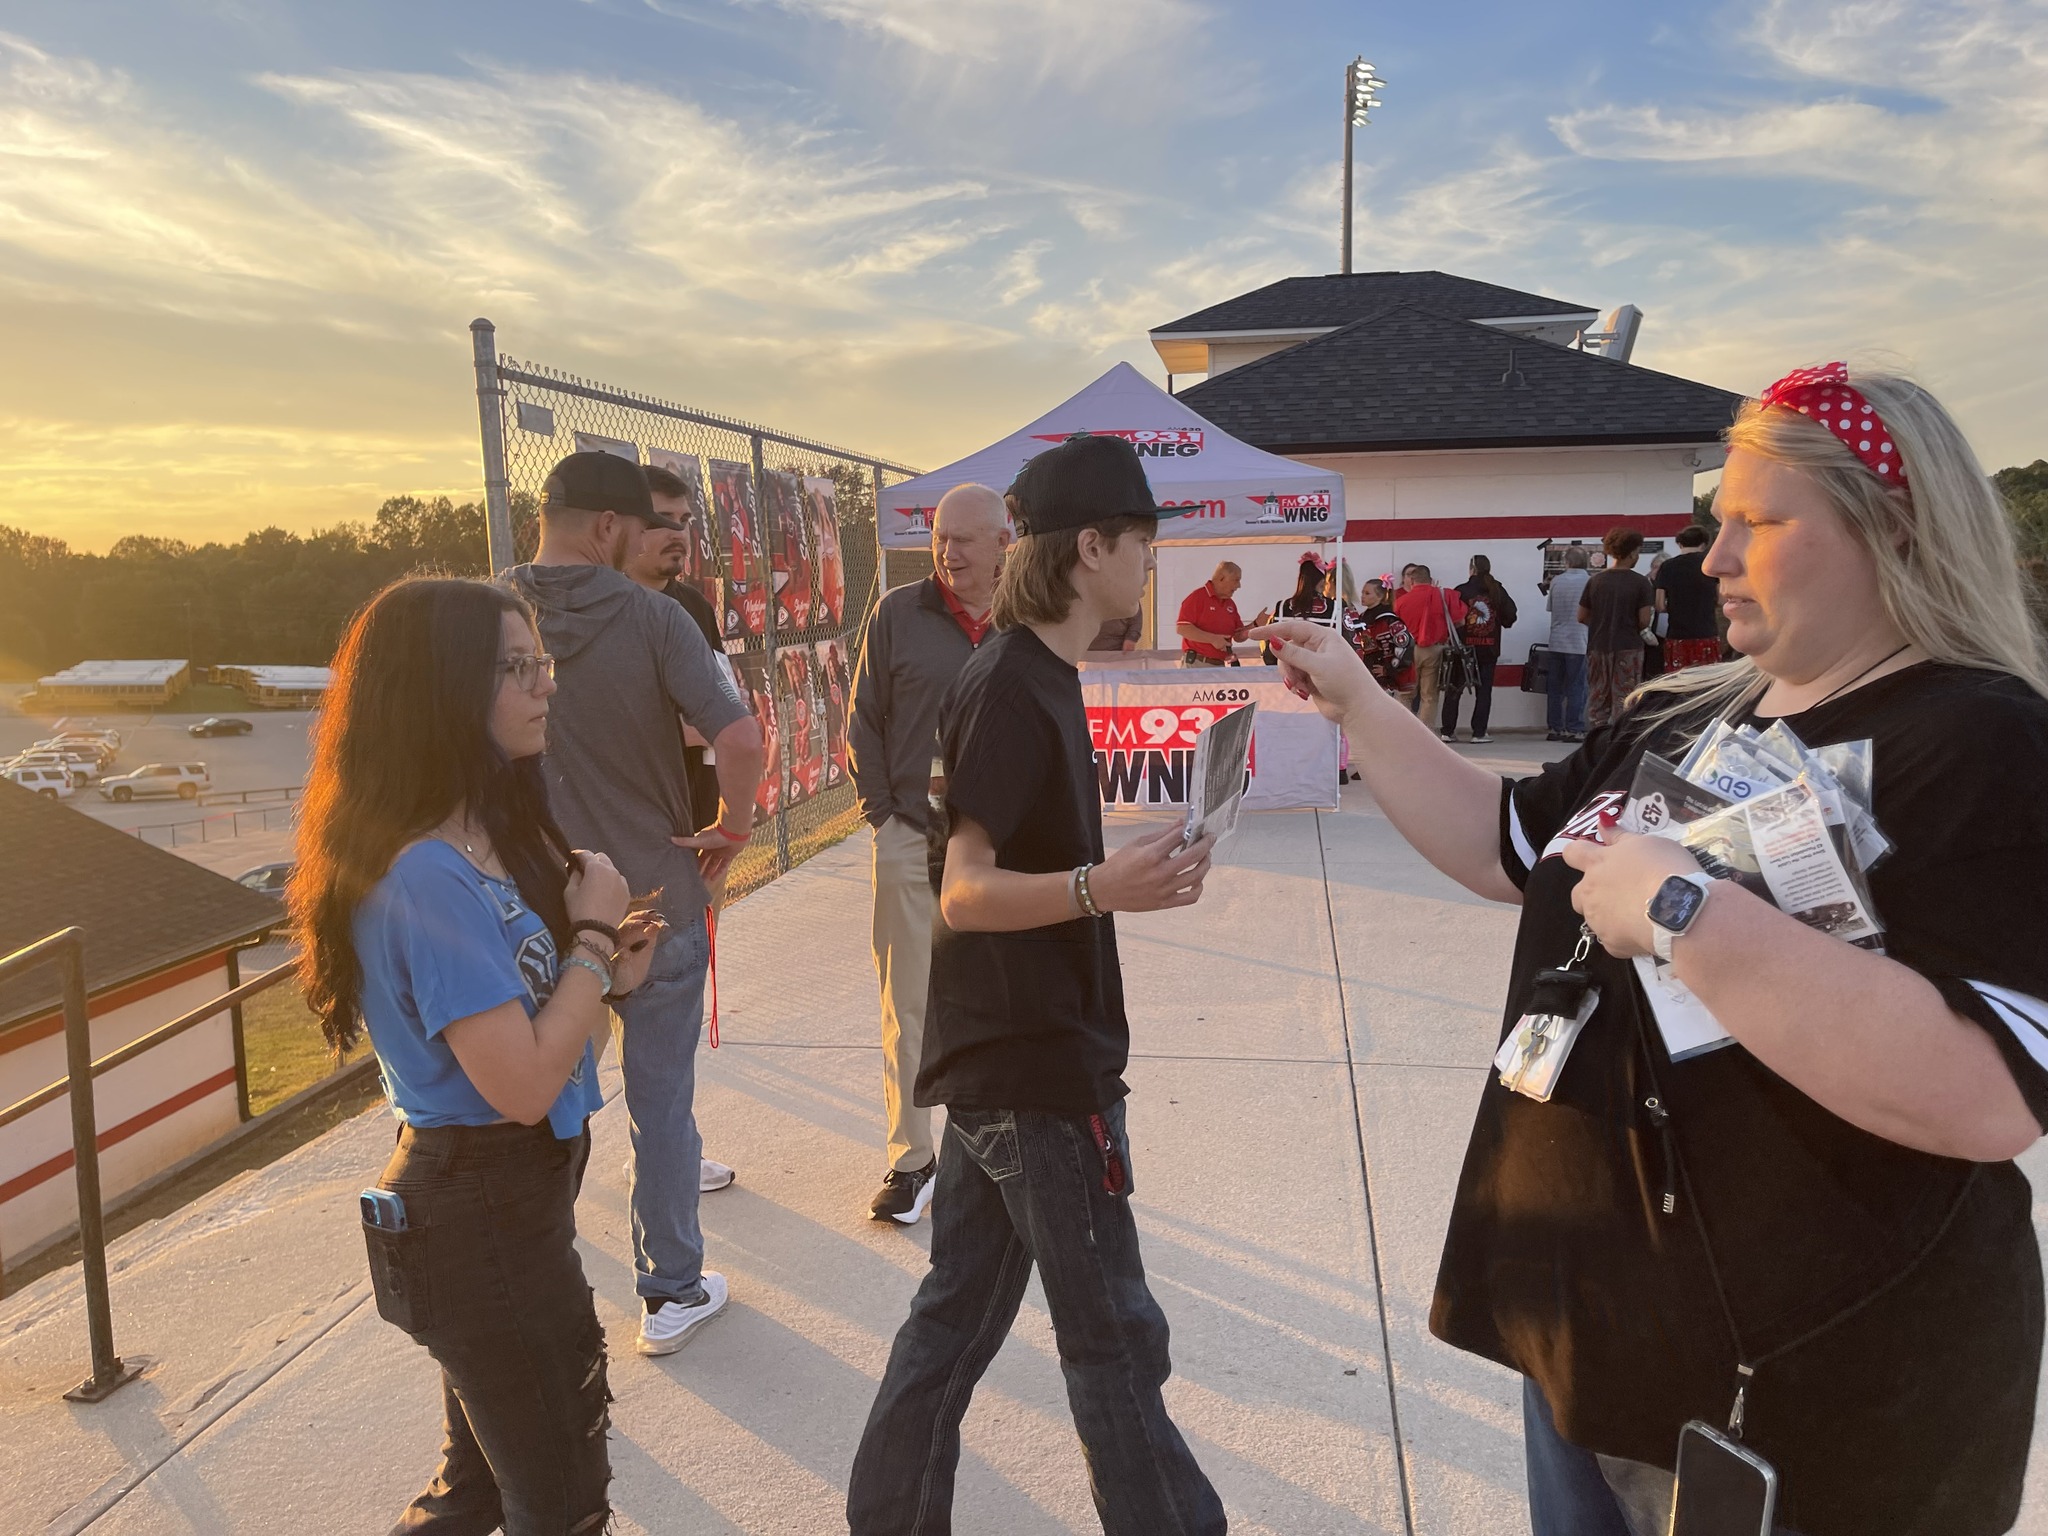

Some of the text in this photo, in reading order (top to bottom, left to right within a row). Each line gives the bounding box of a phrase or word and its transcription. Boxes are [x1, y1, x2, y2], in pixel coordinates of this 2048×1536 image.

[1134, 443, 1200, 457] NEG
[694, 475, 714, 562] Senior
[746, 481, 763, 559] Senior
[1283, 507, 1328, 523] WNEG
[762, 667, 779, 743] Senior
[806, 659, 820, 730] Senior
[1192, 689, 1250, 702] AM630
[1641, 802, 1663, 827] 43
